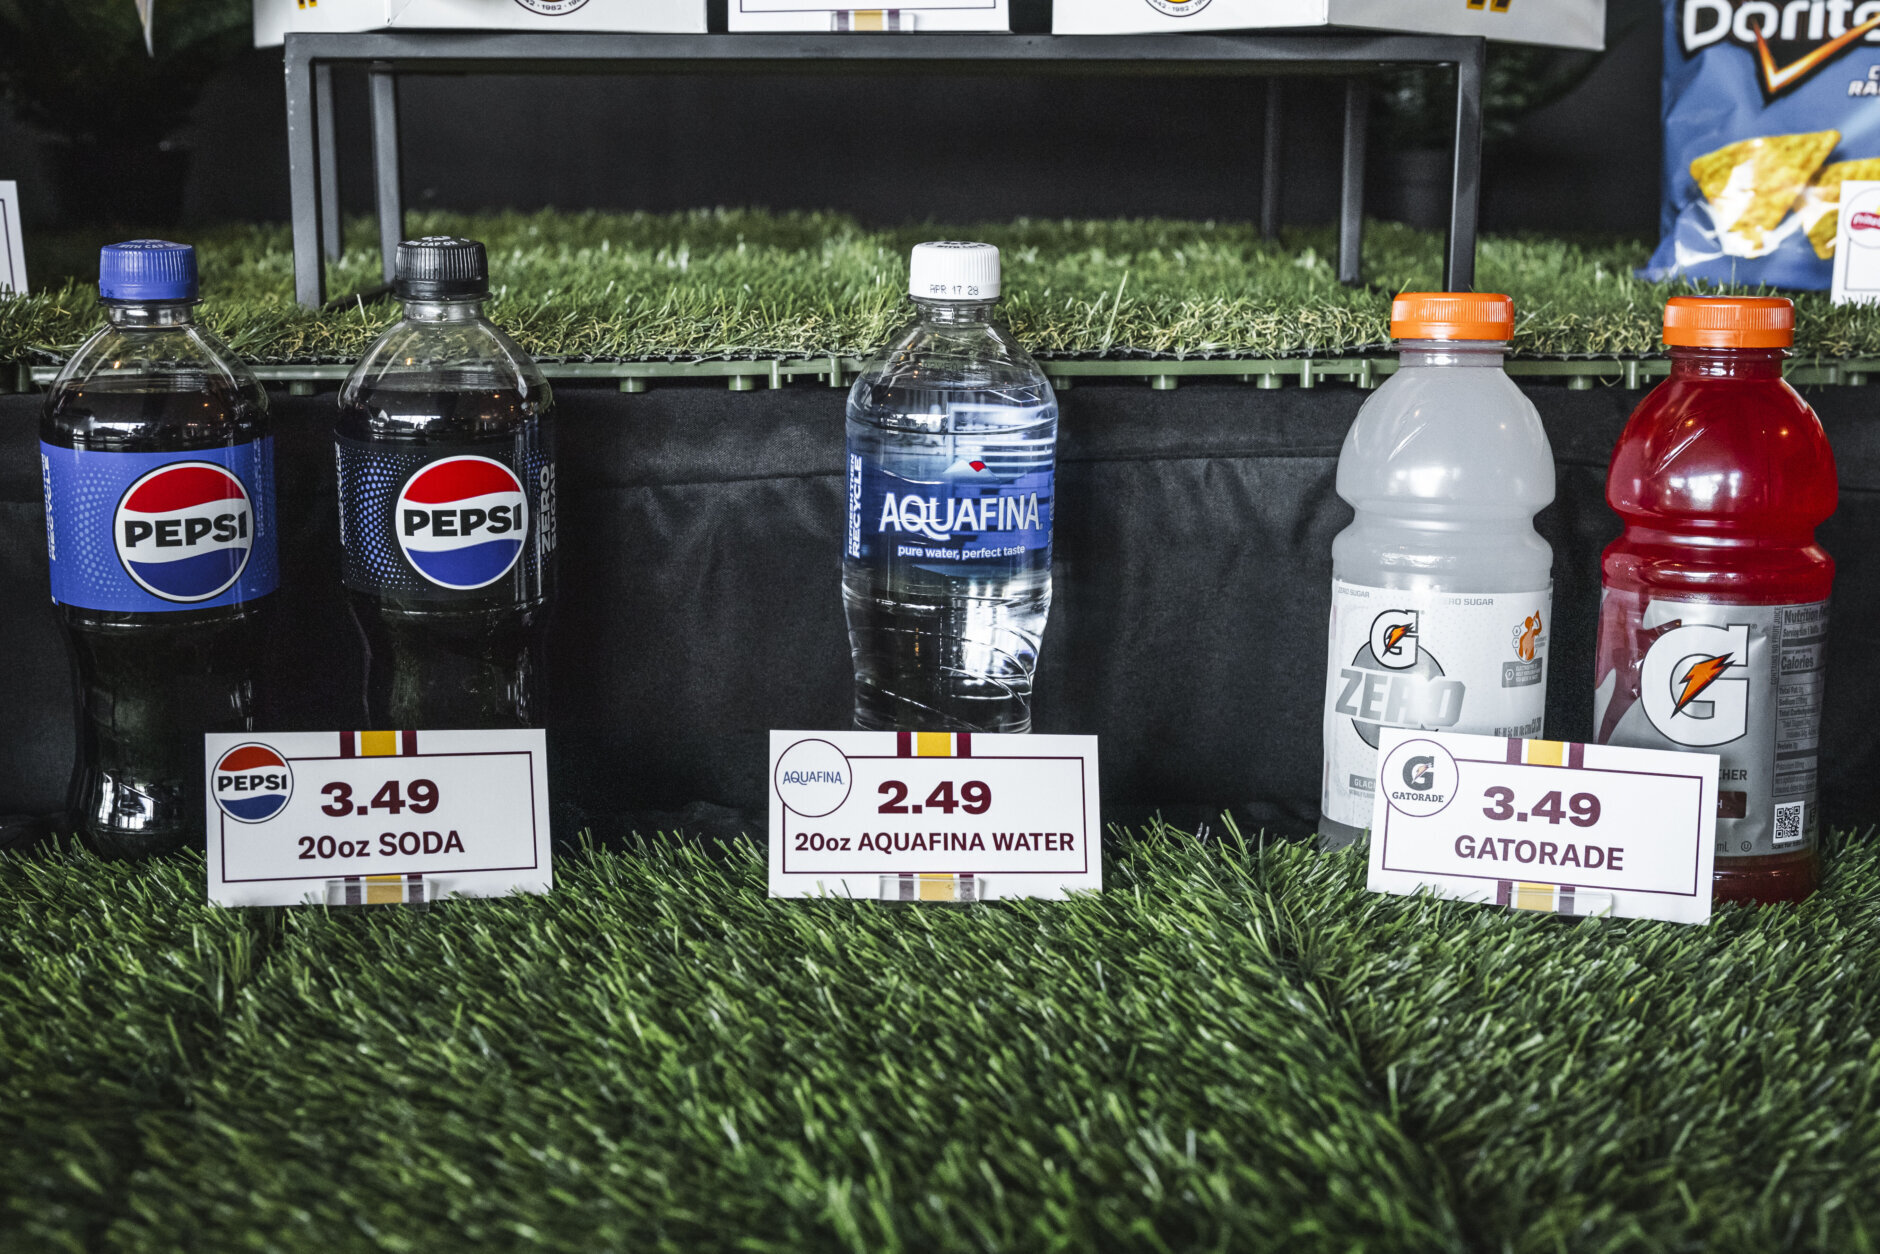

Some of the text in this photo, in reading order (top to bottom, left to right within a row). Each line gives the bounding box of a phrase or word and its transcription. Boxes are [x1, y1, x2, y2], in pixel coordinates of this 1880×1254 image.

[930, 284, 979, 295] APR 17 28
[404, 502, 522, 537] PEPSI
[540, 465, 551, 555] ZERO
[852, 454, 862, 559] RECYCLE
[879, 491, 1040, 541] AQUAFINA
[124, 511, 248, 548] PEPSI
[897, 544, 1026, 560] pure water, perfect taste
[1463, 598, 1494, 606] SUGAR
[1781, 654, 1814, 670] Calories
[1335, 668, 1466, 727] ZERO
[218, 774, 287, 791] PEPSI
[782, 771, 843, 786] AQUAFINA
[320, 778, 440, 818] 3.49
[877, 780, 992, 815] 2.49
[1392, 791, 1444, 803] GATORADE
[1482, 785, 1602, 828] 3.49
[298, 830, 465, 860] 20oz SODA
[795, 832, 1075, 855] 20oz AQUAFINA WATER
[1454, 834, 1624, 871] GATORADE
